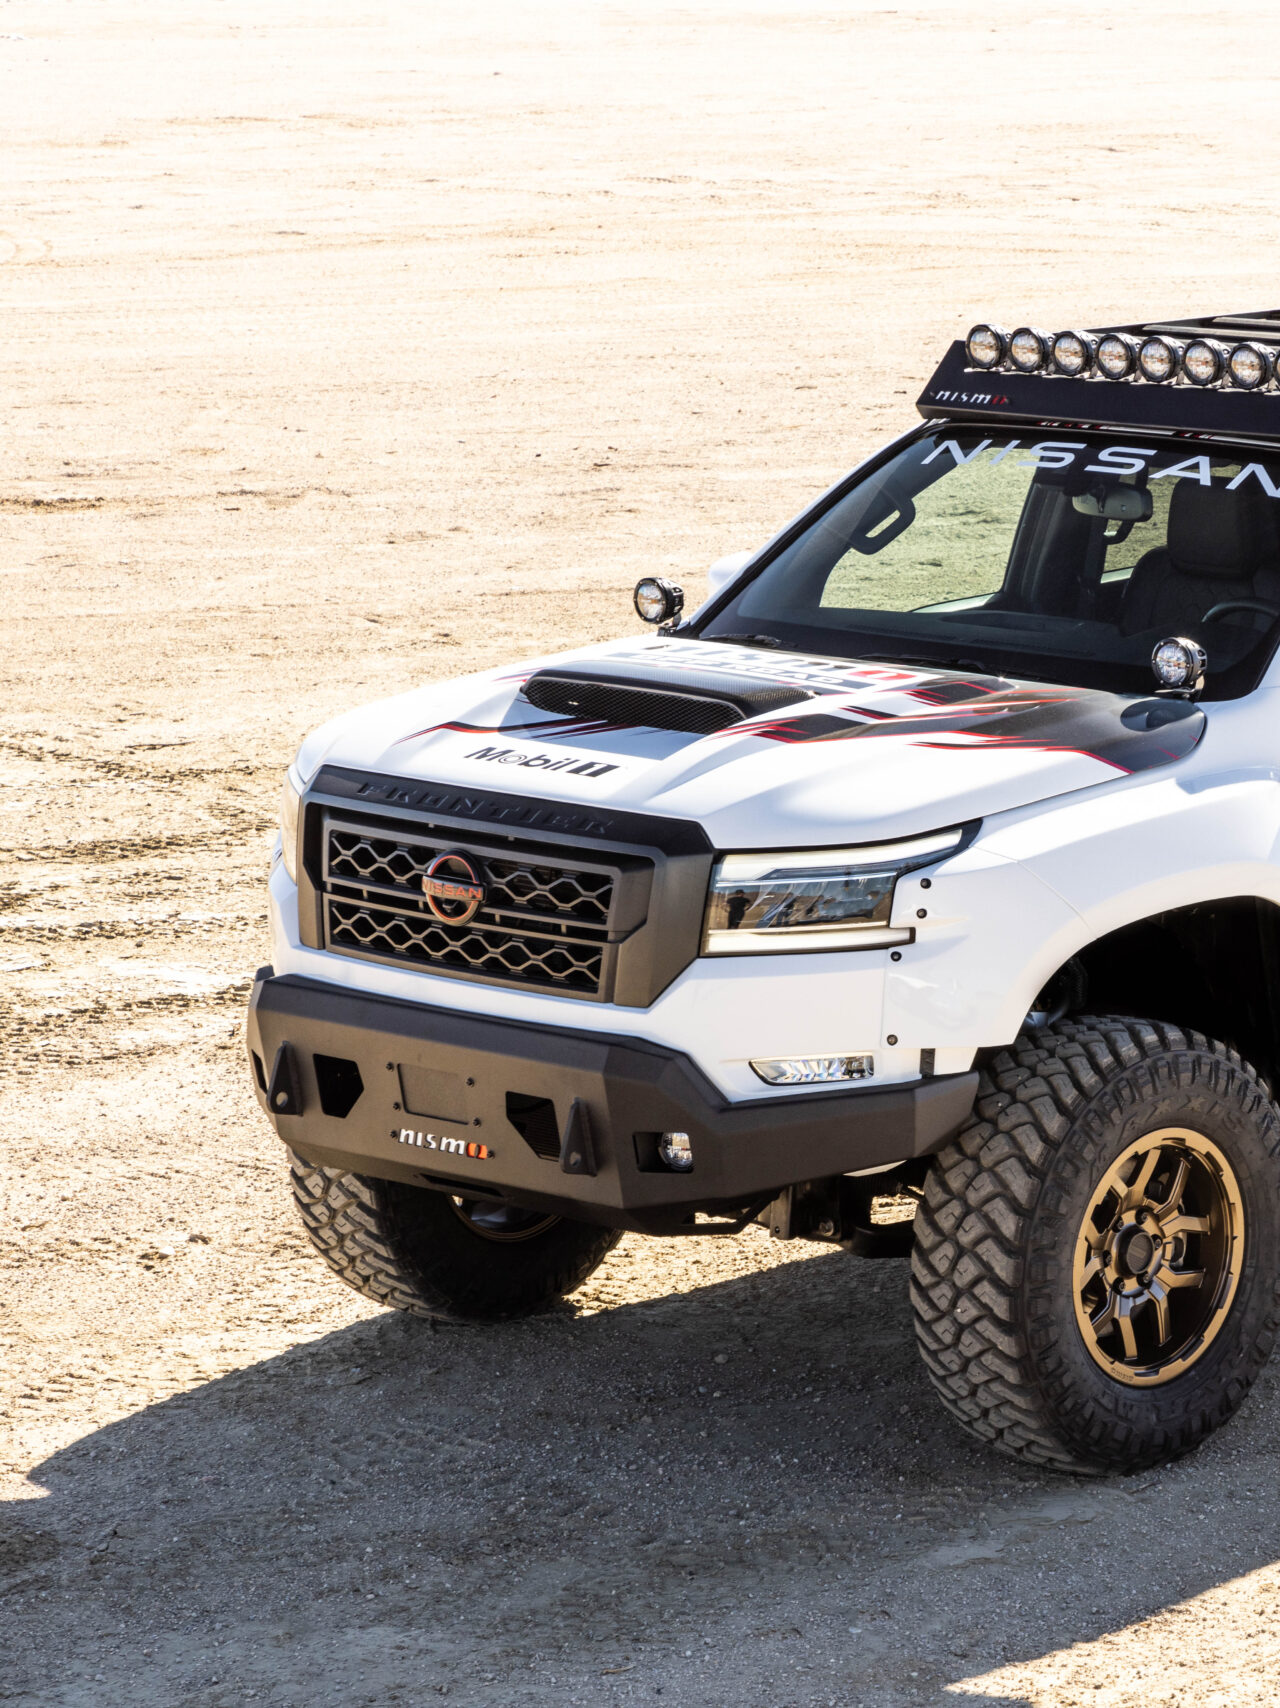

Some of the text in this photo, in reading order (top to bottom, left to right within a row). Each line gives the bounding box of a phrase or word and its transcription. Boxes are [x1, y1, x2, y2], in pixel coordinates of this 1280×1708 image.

[464, 746, 581, 771] Mobil
[356, 782, 614, 834] FRONTIER
[423, 879, 482, 899] NISSAN
[399, 1128, 488, 1160] nismo
